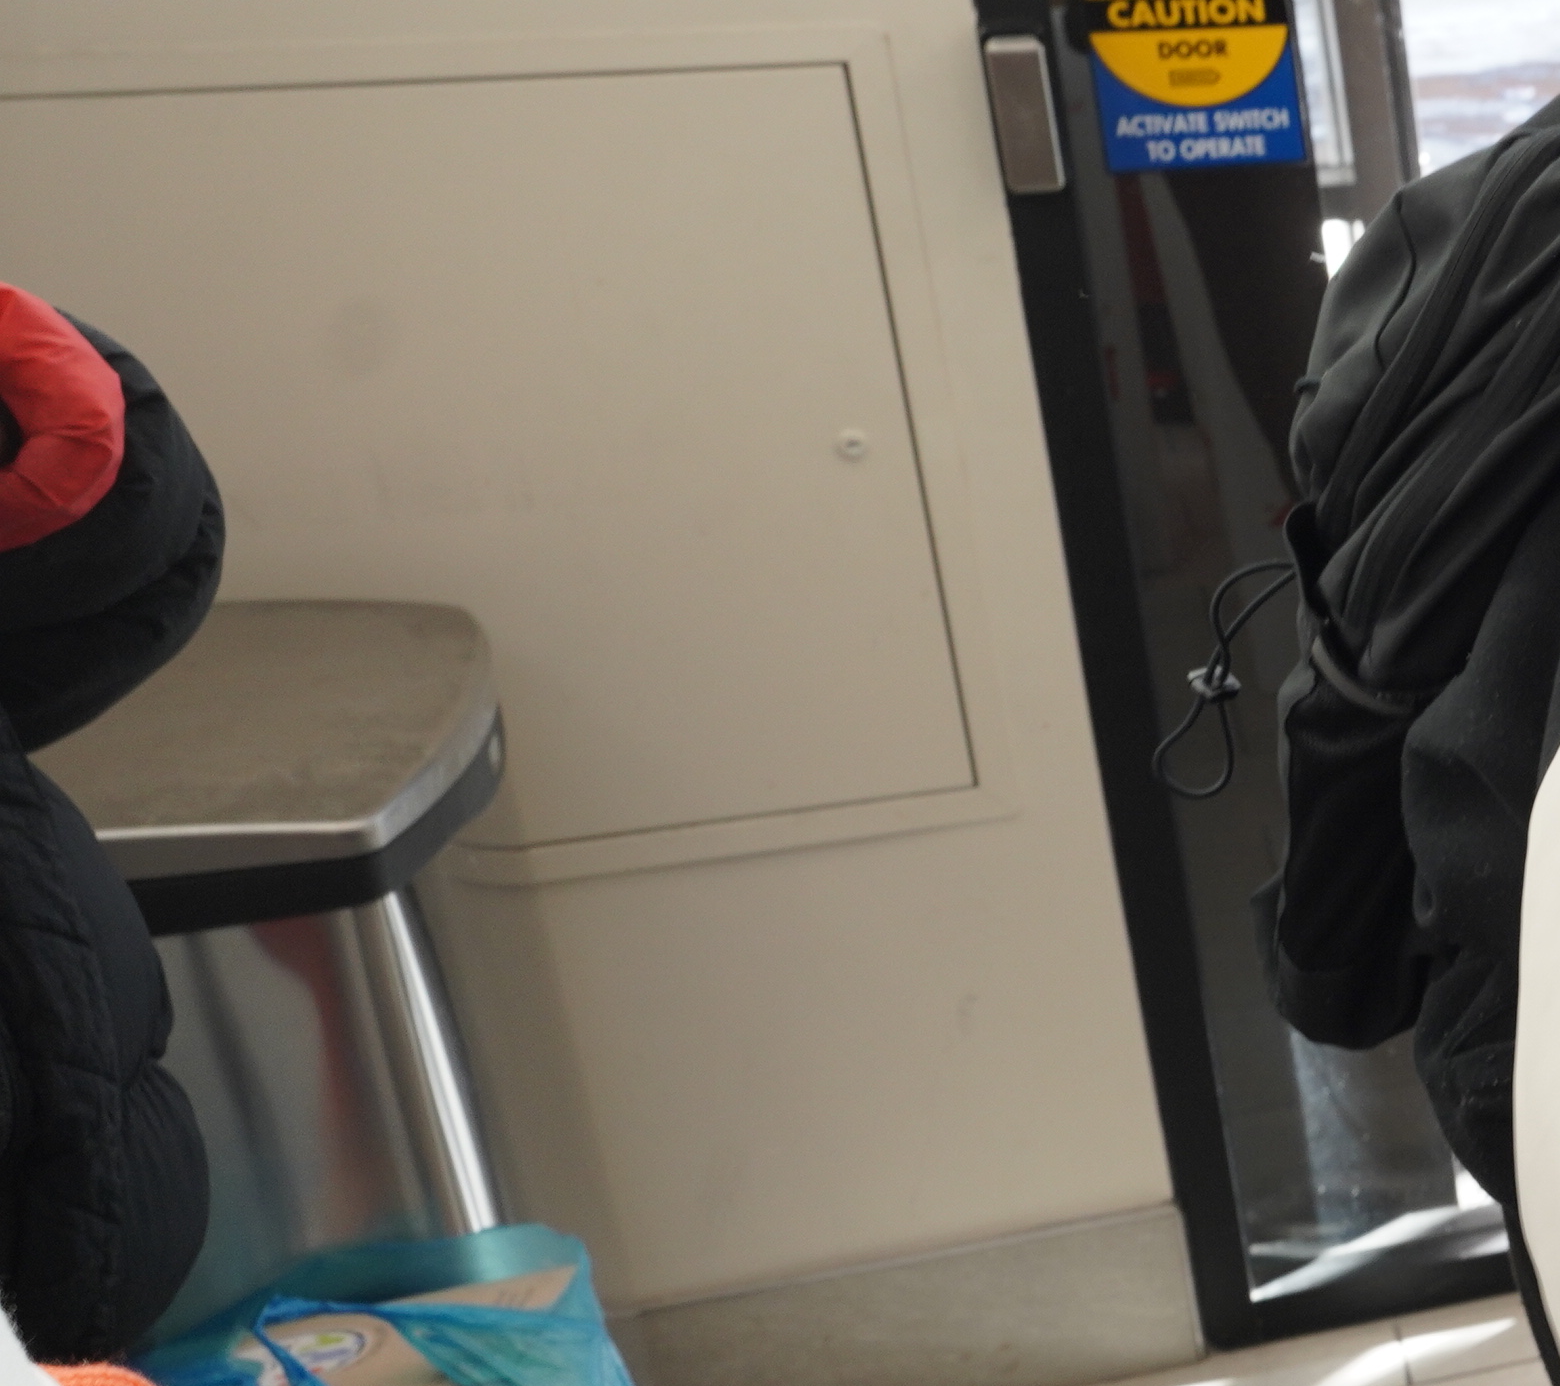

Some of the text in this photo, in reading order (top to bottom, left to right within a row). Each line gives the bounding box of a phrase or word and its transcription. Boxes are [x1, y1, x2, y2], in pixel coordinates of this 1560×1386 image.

[1158, 40, 1227, 59] DOOR
[1115, 107, 1290, 138] ACTIVATE SWITCH
[1146, 134, 1267, 161] TO OPERATE
